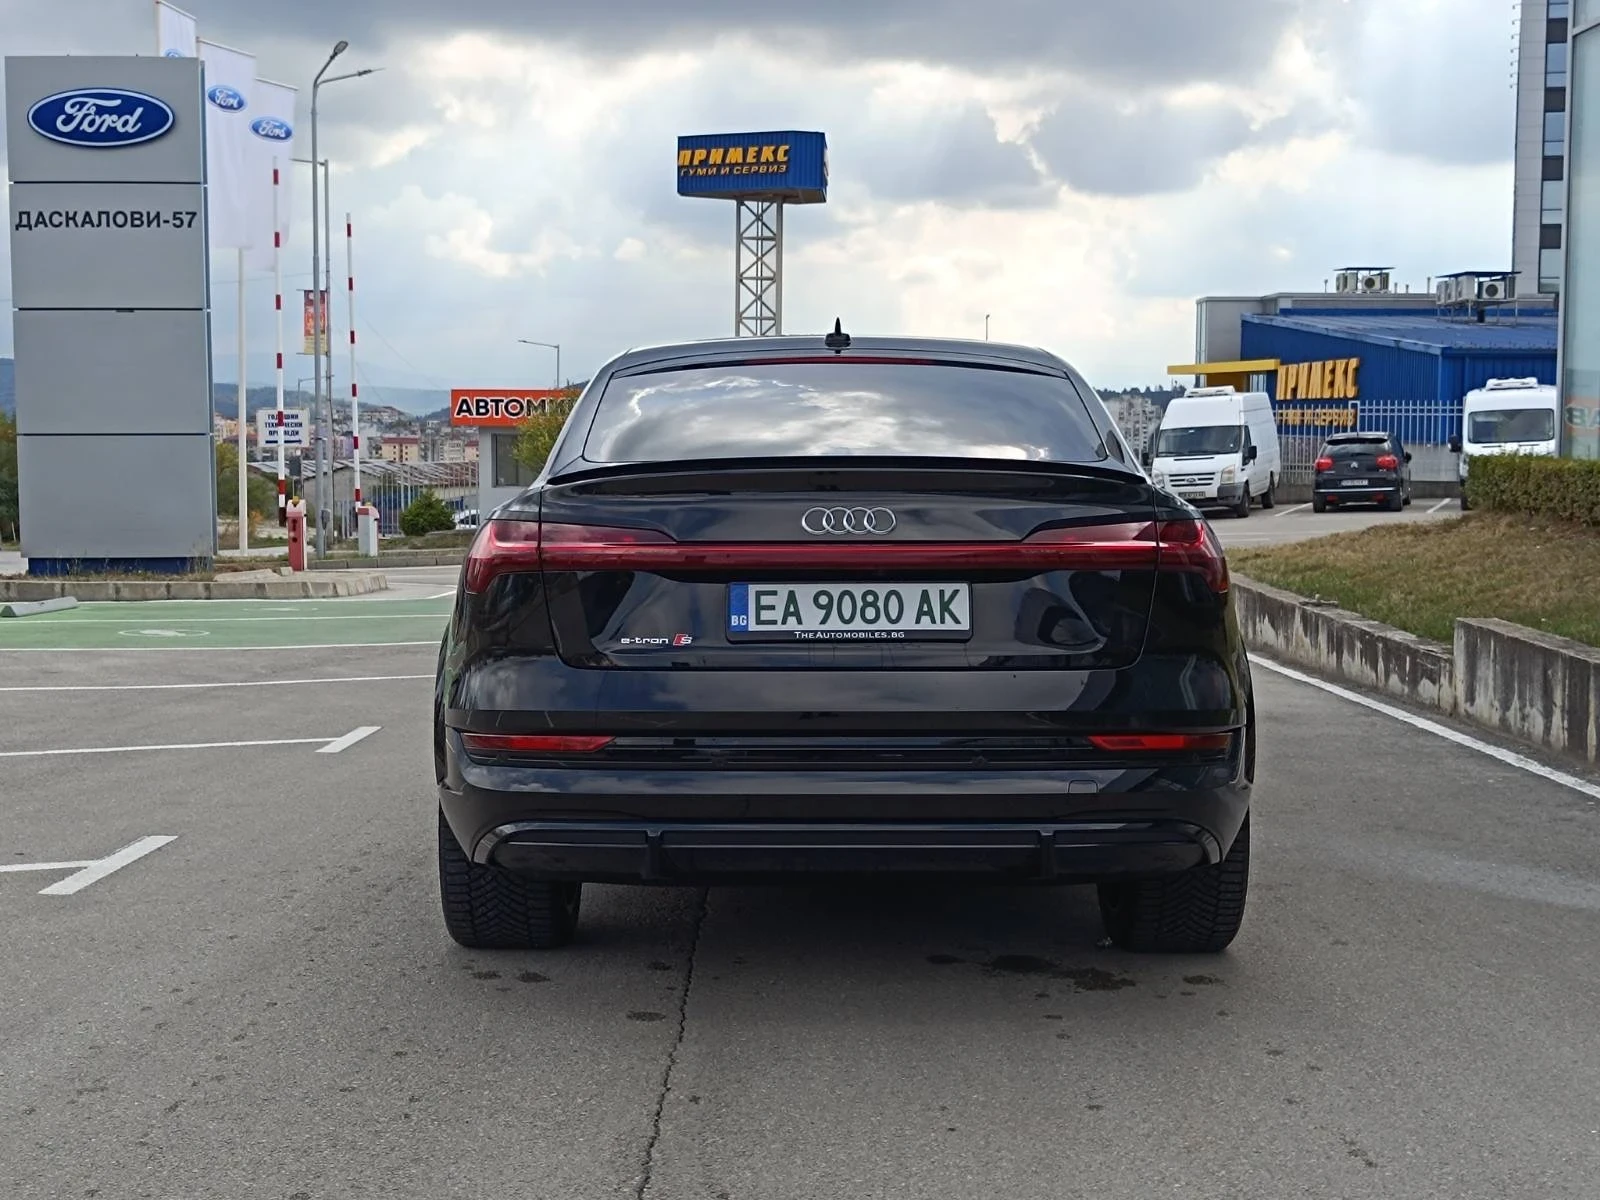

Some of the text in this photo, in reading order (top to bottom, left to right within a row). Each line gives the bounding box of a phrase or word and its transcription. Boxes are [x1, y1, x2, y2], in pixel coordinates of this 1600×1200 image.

[214, 88, 240, 108] Ford
[56, 97, 144, 133] Ford
[679, 145, 789, 166] ПРИМЕКС
[681, 164, 787, 176] ГУМИ И СЕРВИЗ
[15, 211, 197, 231] ДАСКАЛОВИ-57
[1276, 358, 1360, 400] ПРИМЕКС
[731, 590, 962, 626] BG EA 9080 AK
